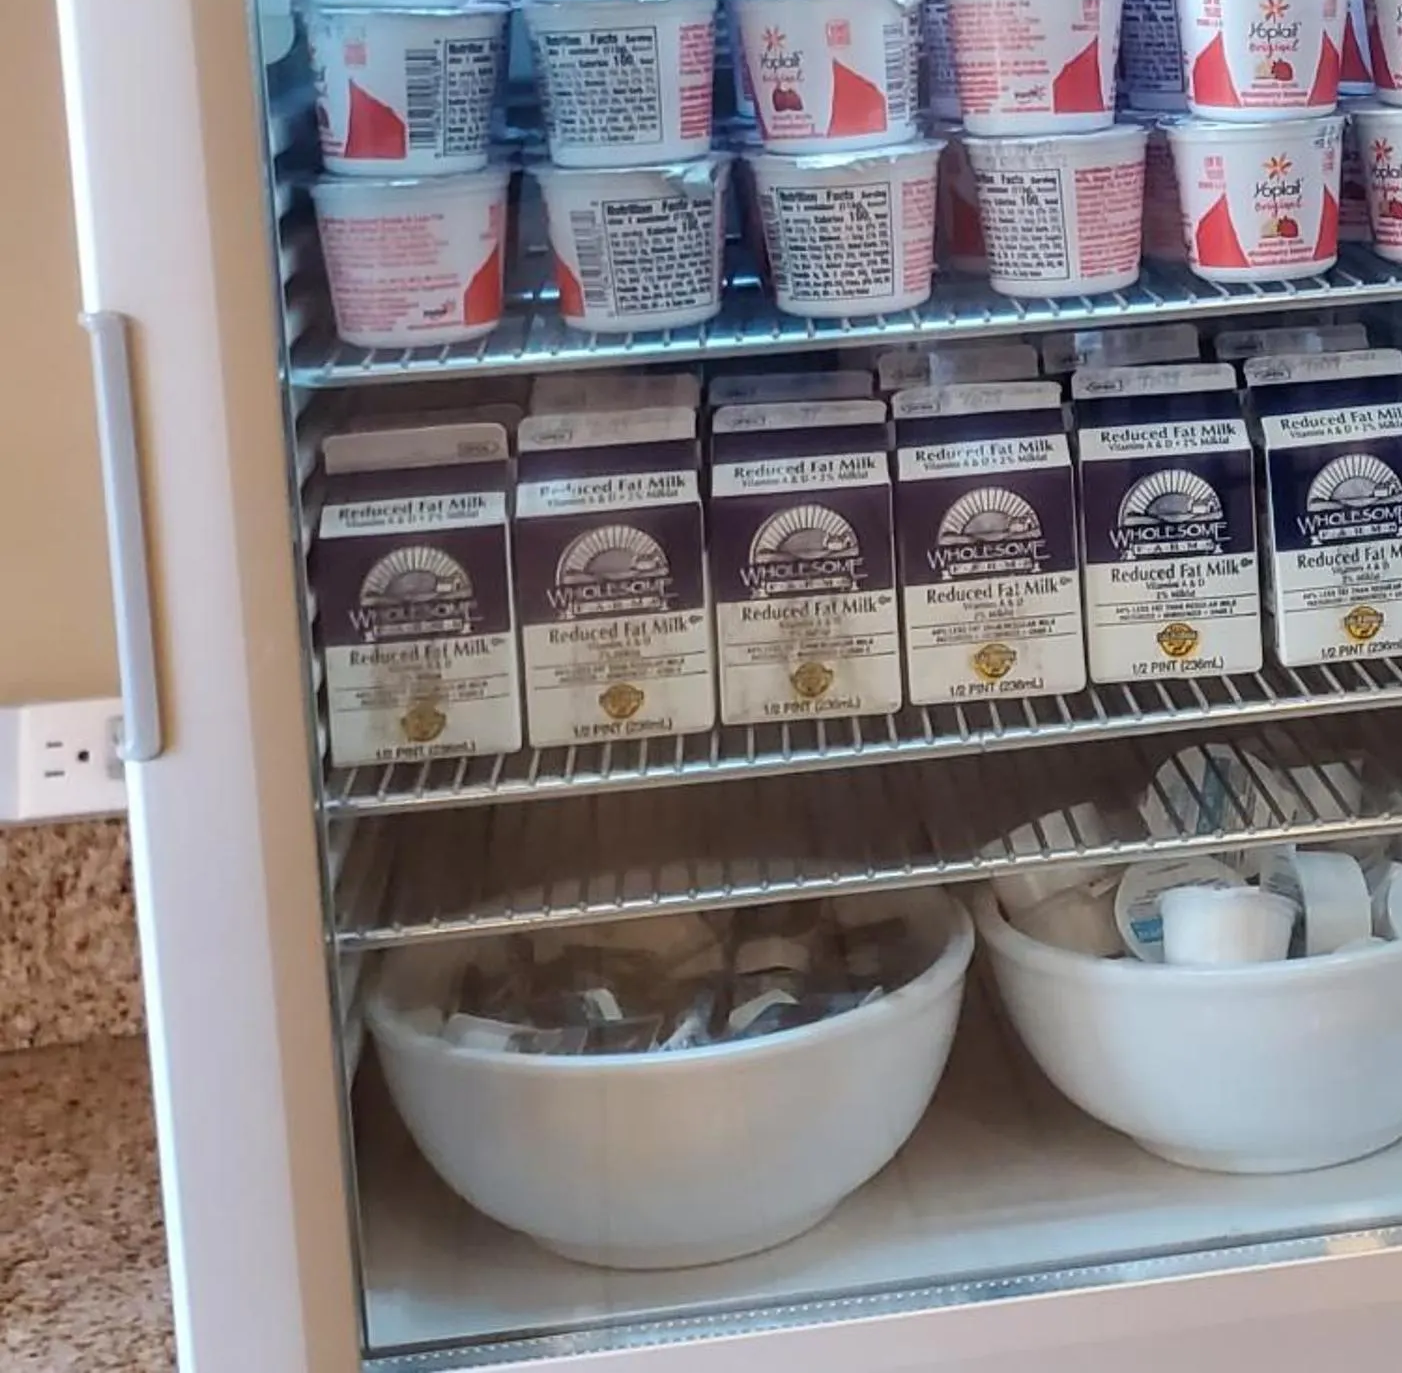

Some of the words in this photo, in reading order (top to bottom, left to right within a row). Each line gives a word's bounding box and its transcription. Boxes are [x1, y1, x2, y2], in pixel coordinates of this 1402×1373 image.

[1280, 412, 1346, 431] Reduced
[1350, 409, 1373, 424] Fat
[1100, 427, 1168, 443] Reduced
[1174, 425, 1197, 439] Fat
[1201, 422, 1237, 436] Milk
[915, 445, 985, 462] Reduced
[990, 443, 1012, 459] Fat
[1019, 438, 1054, 454] Milk
[734, 462, 805, 478] Reduced
[810, 460, 834, 474] Fat
[839, 456, 876, 471] Milk
[1109, 521, 1232, 550] WHOLESOME
[927, 539, 1050, 570] WHOLESOME
[1297, 551, 1360, 569] Reduced
[1364, 547, 1385, 563] Fat
[1111, 565, 1175, 583] Reduced
[1180, 562, 1202, 579] Fat
[1206, 559, 1240, 577] Milk
[926, 585, 992, 605] Reduced
[997, 582, 1019, 599] Fat
[1025, 577, 1059, 596] Milk
[742, 602, 809, 622] Reduced
[814, 600, 837, 616] Fat
[842, 596, 877, 614] Milk
[549, 623, 618, 644] Reduced
[624, 620, 647, 637] Fat
[652, 617, 687, 635] Milk
[349, 645, 420, 666] Reduced
[425, 641, 448, 660] Fat
[454, 638, 491, 657] Milk
[1132, 662, 1147, 675] 1/2
[1151, 659, 1177, 673] PINT
